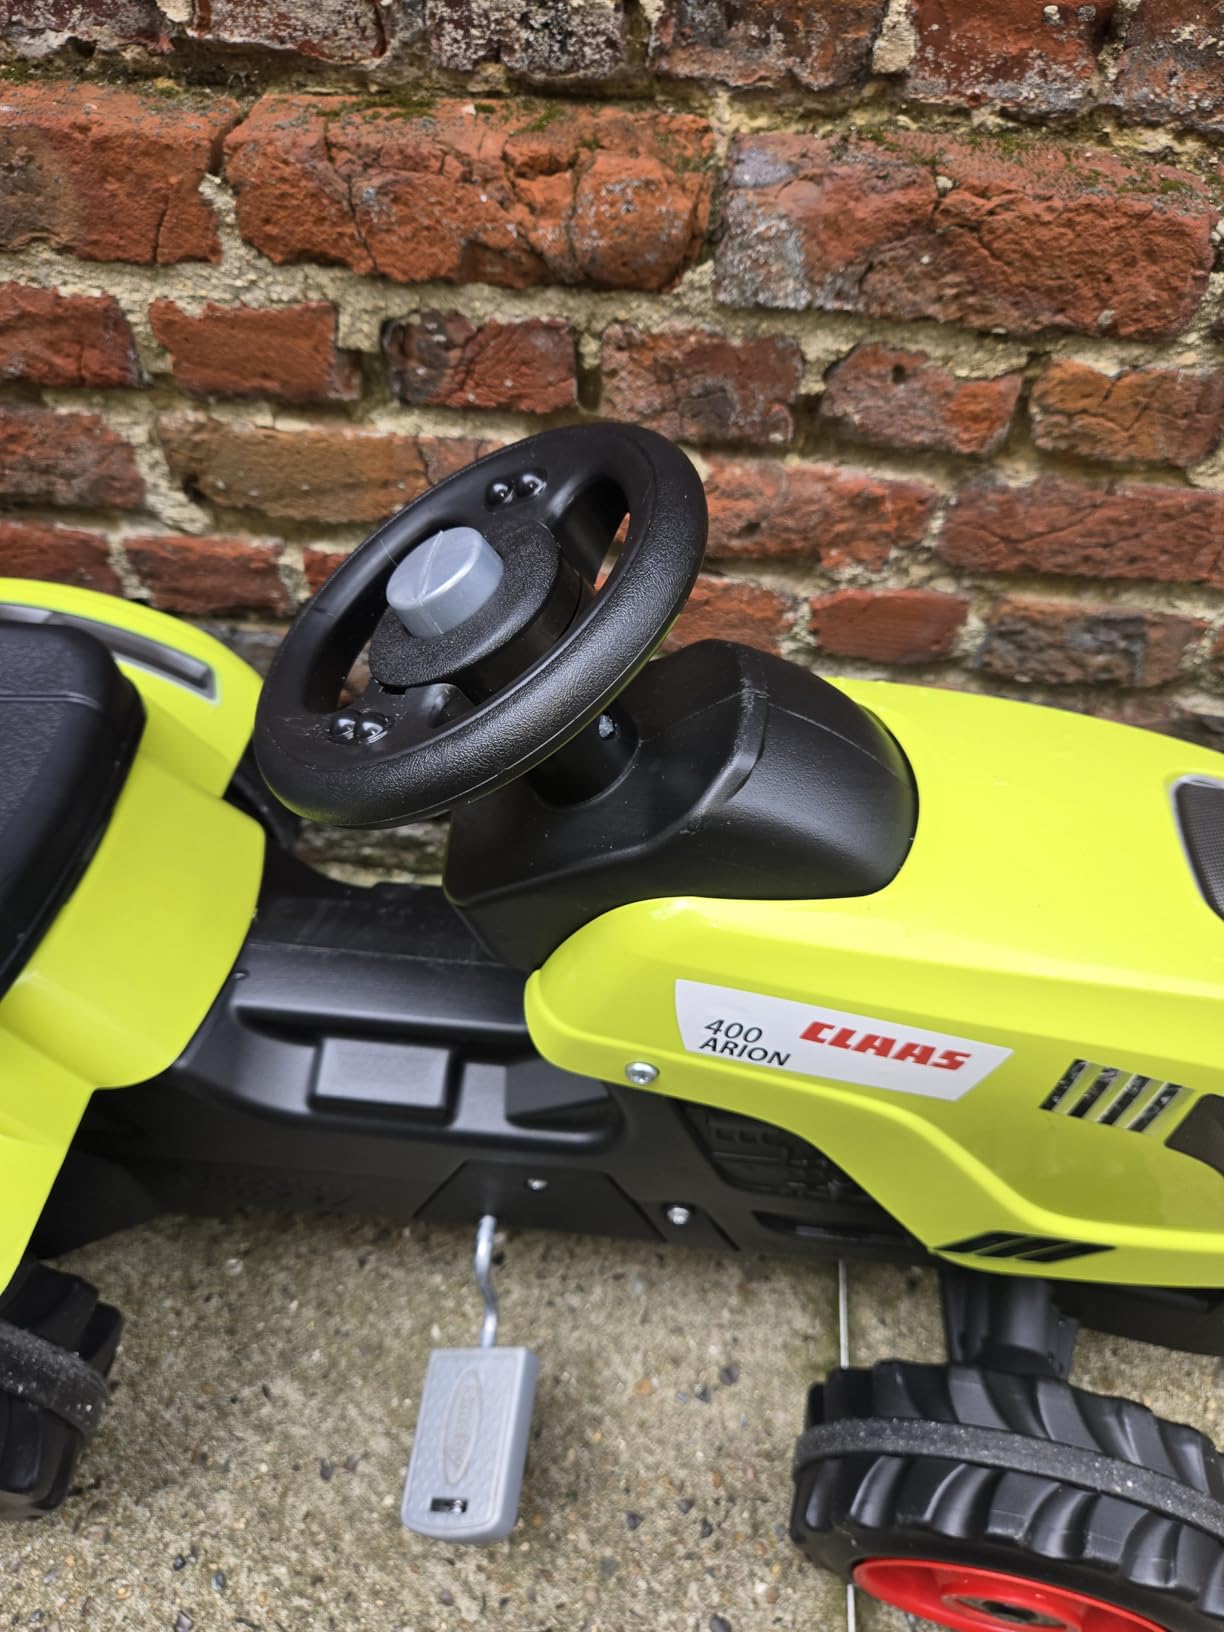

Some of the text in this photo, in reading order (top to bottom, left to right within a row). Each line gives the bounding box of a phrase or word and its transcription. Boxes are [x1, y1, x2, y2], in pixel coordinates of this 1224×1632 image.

[704, 1019, 763, 1043] 400
[699, 1037, 792, 1066] ARION
[799, 1021, 972, 1071] CLAAS
